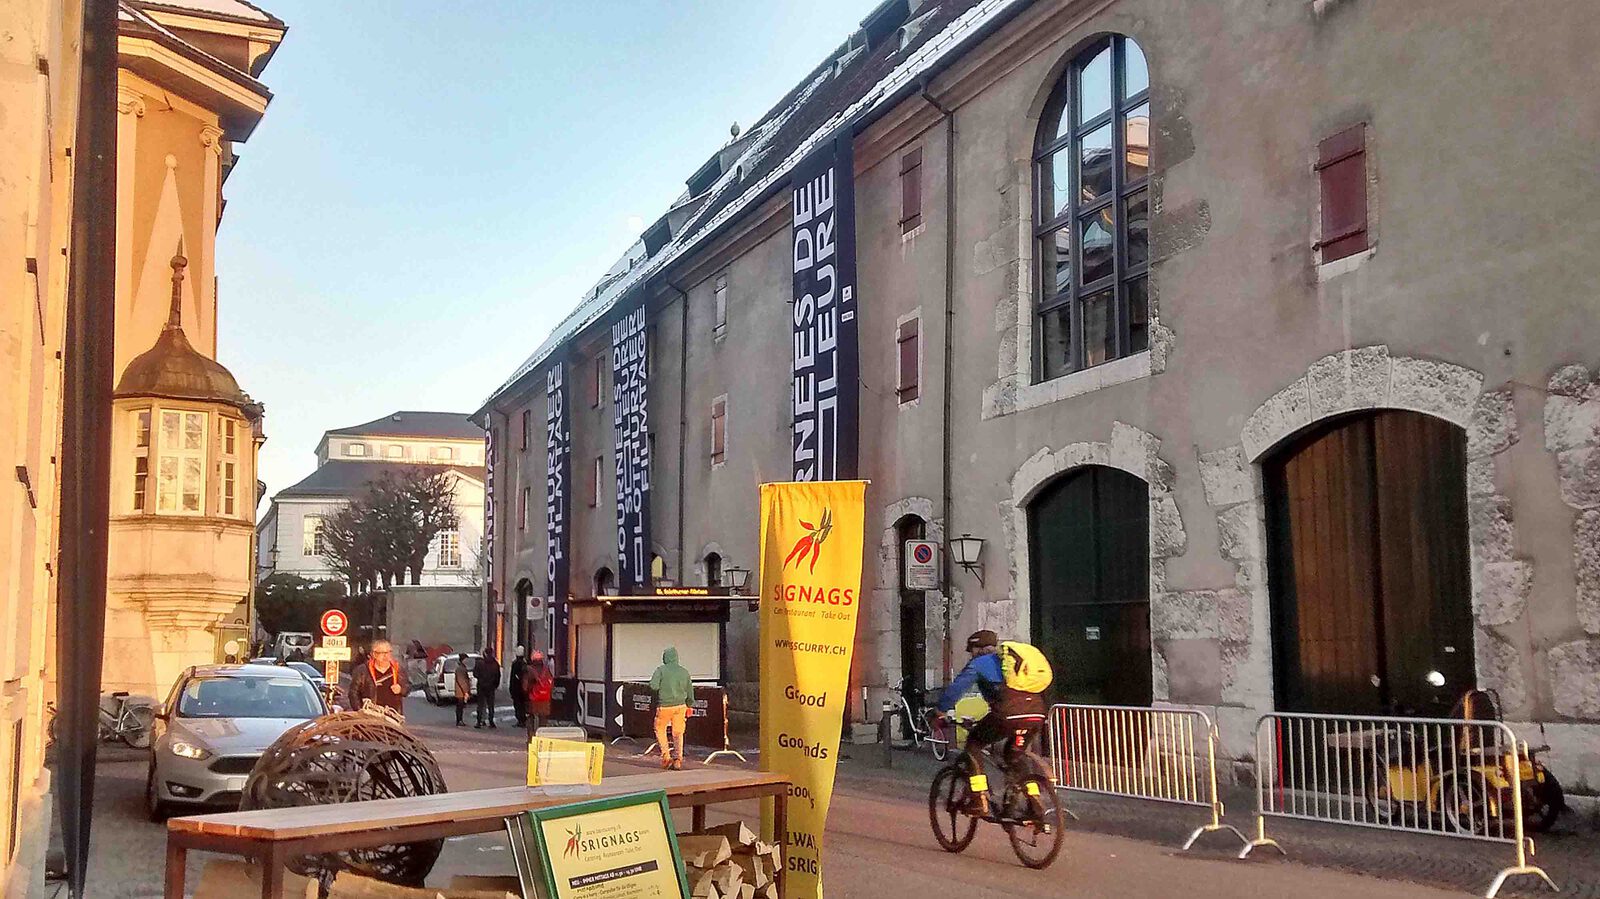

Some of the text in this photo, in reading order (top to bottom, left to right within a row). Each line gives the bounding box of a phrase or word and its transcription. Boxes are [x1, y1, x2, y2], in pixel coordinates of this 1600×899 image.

[794, 181, 814, 274] DE
[555, 362, 563, 559] FILMTAGE
[612, 322, 627, 571] JOURNEES DE
[637, 304, 649, 492] FILMTAGE
[581, 830, 640, 852] SRIGNAGS
